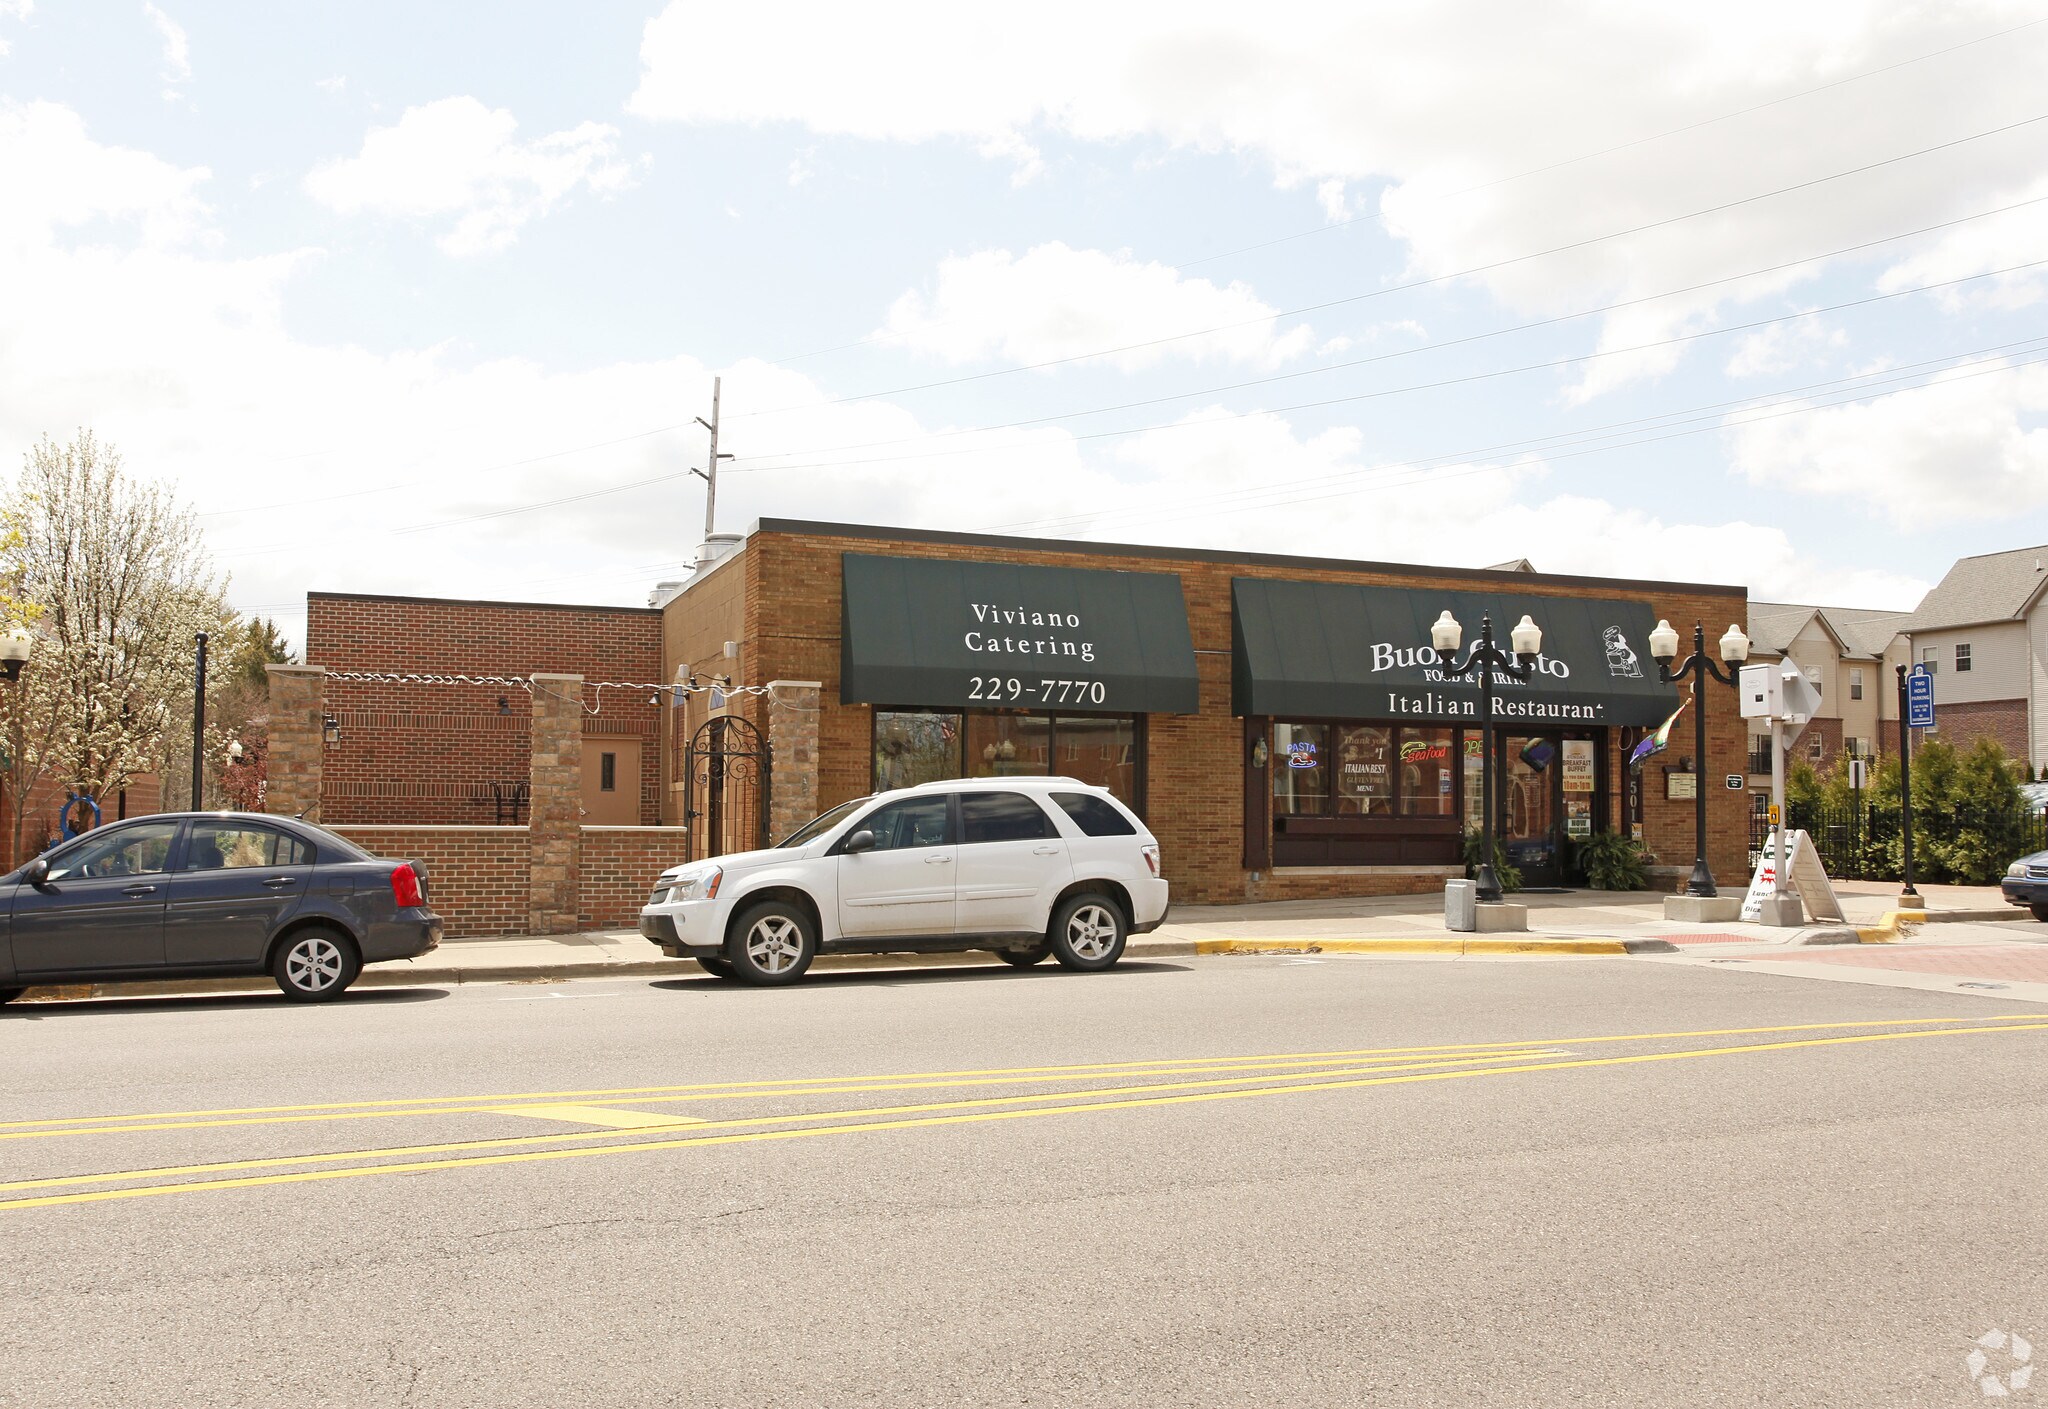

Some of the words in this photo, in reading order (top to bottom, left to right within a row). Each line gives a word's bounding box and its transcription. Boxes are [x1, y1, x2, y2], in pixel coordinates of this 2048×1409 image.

[971, 603, 1080, 628] Viviano
[964, 632, 1095, 662] Catering
[1465, 672, 1475, 683] &
[968, 676, 1106, 704] 229-7770
[1388, 693, 1475, 716] Italian
[1286, 742, 1317, 754] PASTA
[1344, 736, 1370, 745] Thank
[1464, 740, 1483, 754] OPE
[1345, 764, 1370, 774] ITALIAN
[1370, 764, 1386, 774] BEST
[1629, 781, 1638, 821] 501
